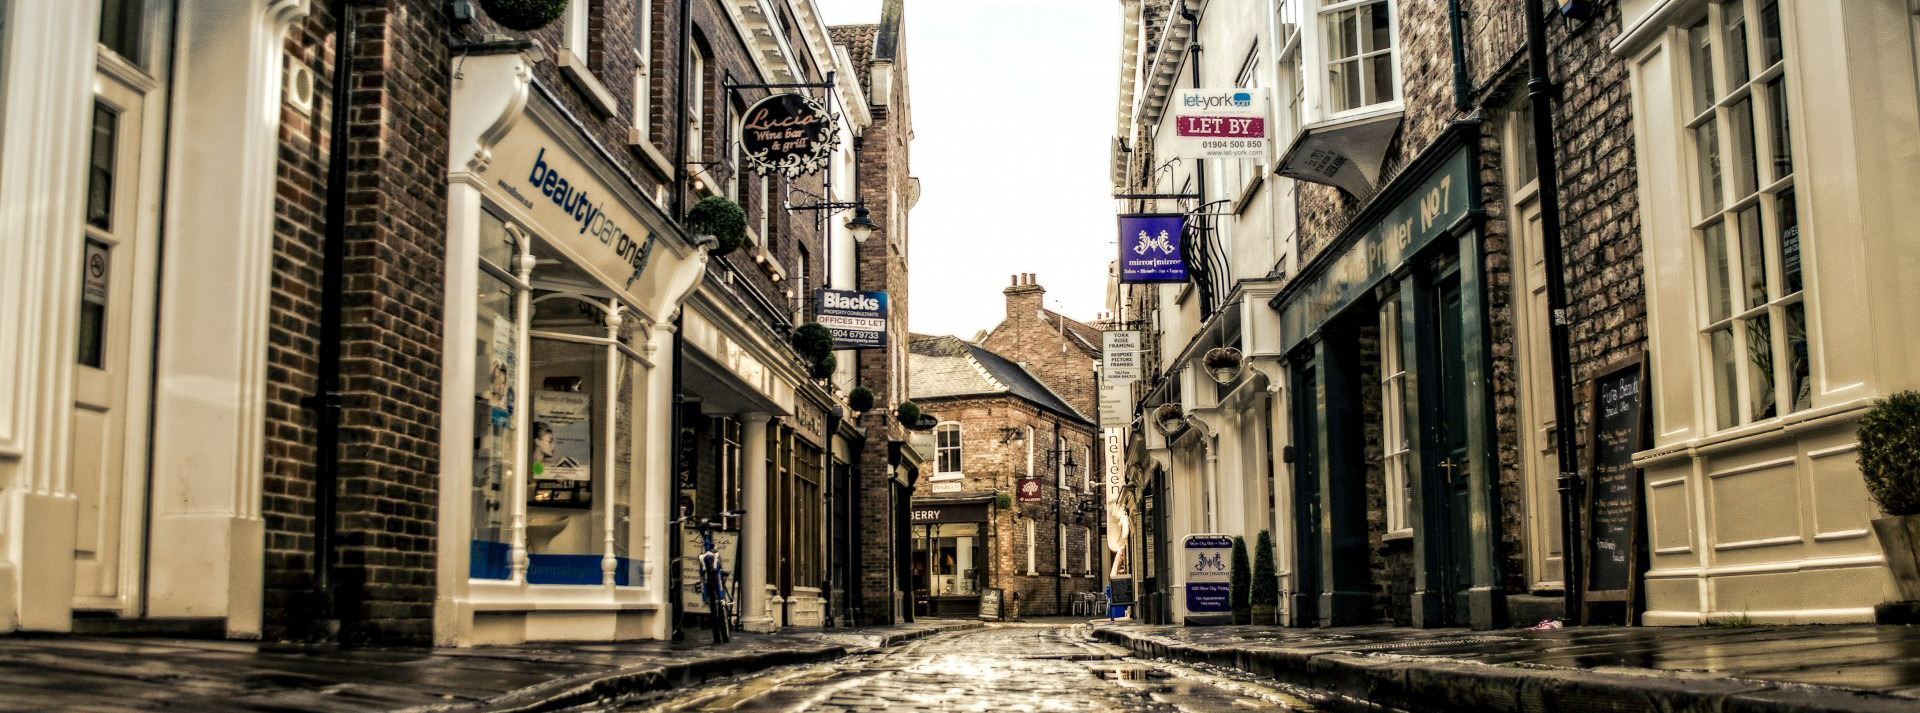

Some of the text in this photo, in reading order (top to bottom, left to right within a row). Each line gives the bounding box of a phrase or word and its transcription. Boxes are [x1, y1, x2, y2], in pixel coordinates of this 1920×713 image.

[1183, 93, 1233, 110] let-york
[745, 108, 818, 130] Lucia
[1188, 118, 1252, 135] LET BY
[784, 128, 805, 139] bar
[771, 137, 808, 152] & grill
[1202, 140, 1262, 149] 01904 500 850
[824, 292, 879, 310] Blacks
[819, 316, 853, 325] OFFICES
[849, 330, 878, 339] 679733
[1601, 383, 1619, 405] Pure
[1108, 427, 1120, 494] ineteen
